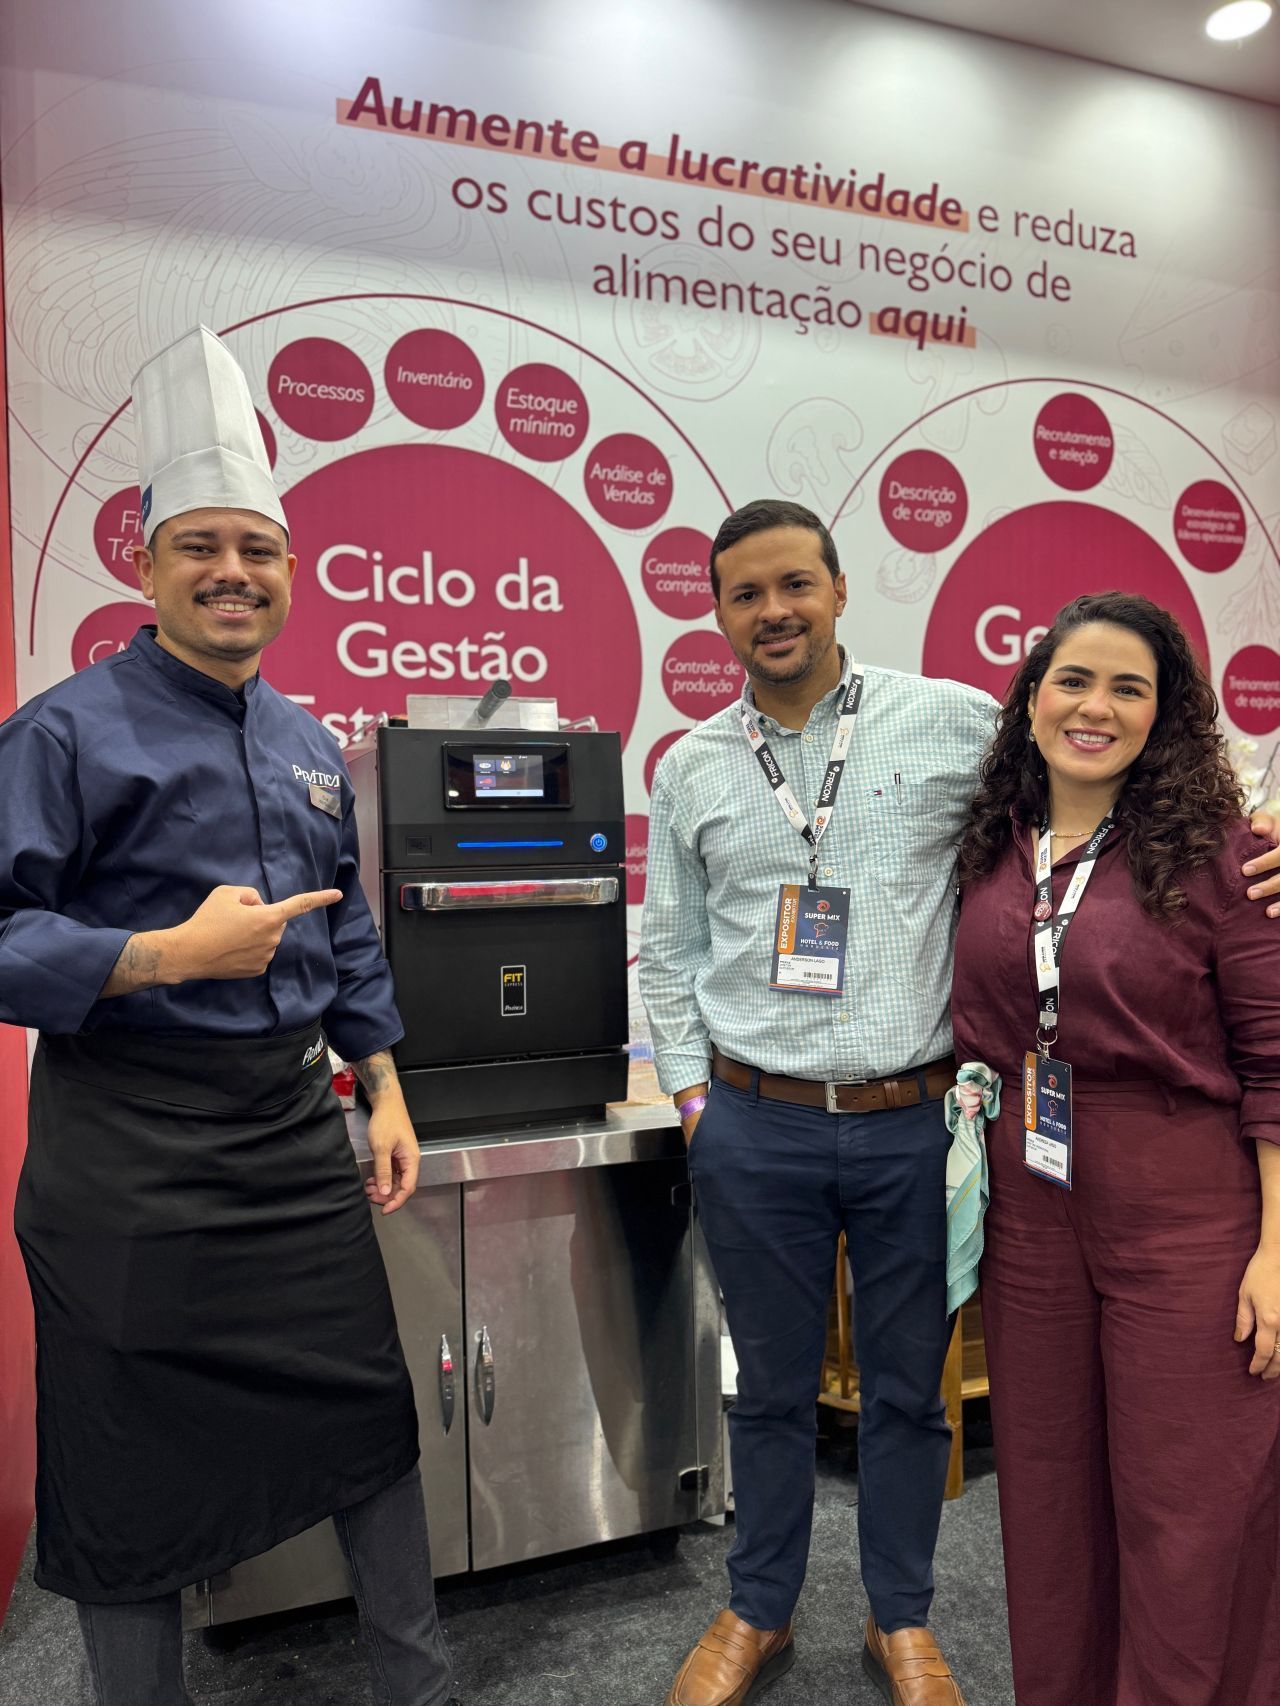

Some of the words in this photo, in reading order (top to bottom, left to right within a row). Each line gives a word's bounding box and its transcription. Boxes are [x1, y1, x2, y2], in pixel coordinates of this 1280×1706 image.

[346, 76, 600, 163] Aumente
[619, 139, 649, 172] a
[666, 133, 964, 227] lucratividade
[978, 204, 999, 232] e
[1013, 208, 1138, 259] reduza
[452, 177, 509, 215] os
[527, 187, 681, 242] custos
[697, 204, 755, 252] do
[771, 225, 841, 267] seu
[858, 242, 1013, 293] negócio
[1026, 260, 1072, 302] de
[592, 253, 863, 336] alimentação
[876, 305, 969, 351] aqui
[277, 374, 366, 404] Processos
[397, 366, 474, 391] Inventário
[505, 387, 578, 417] Estoque
[508, 416, 576, 438] mínimo
[1036, 424, 1112, 449] Recrutamento
[589, 462, 644, 484] Análise
[646, 467, 667, 487] de
[603, 484, 656, 506] Vendas
[888, 480, 957, 507] Descrição
[893, 502, 912, 521] de
[913, 506, 953, 528] cargo
[316, 543, 476, 608] Ciclo
[495, 557, 564, 613] da
[645, 557, 702, 577] Controle
[335, 620, 549, 684] Gestão
[665, 656, 721, 676] Controle
[723, 659, 741, 677] de
[672, 677, 734, 697] produção
[761, 750, 780, 780] FRICON
[821, 770, 836, 802] FRICON
[1086, 827, 1109, 854] FRICON
[780, 897, 793, 949] EXPOSITOR
[804, 912, 826, 920] SUPER
[504, 972, 524, 983] FIT
[1040, 1086, 1056, 1099] SUPER
